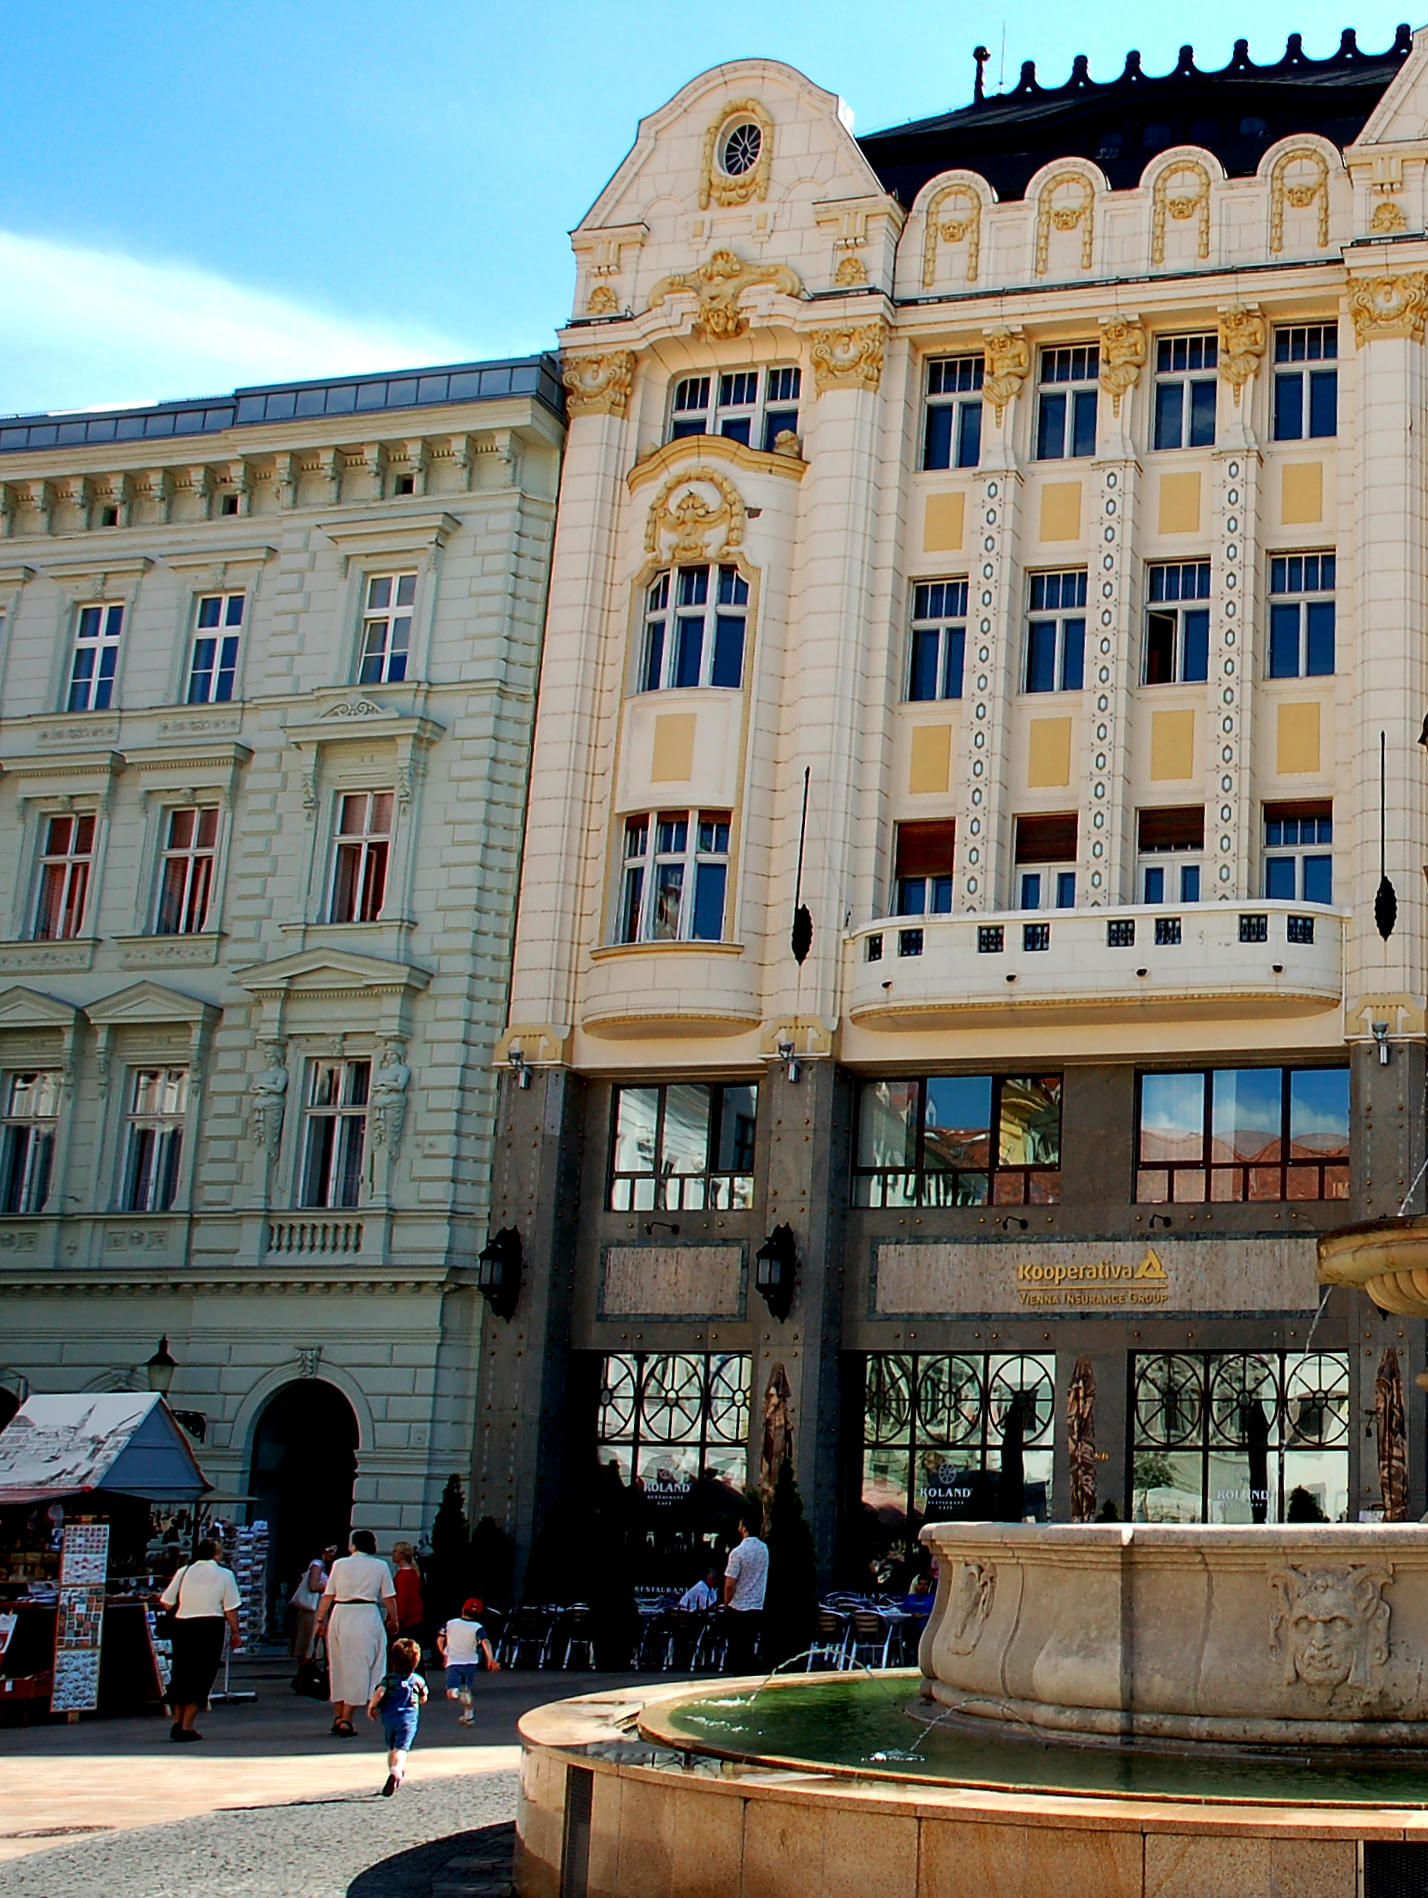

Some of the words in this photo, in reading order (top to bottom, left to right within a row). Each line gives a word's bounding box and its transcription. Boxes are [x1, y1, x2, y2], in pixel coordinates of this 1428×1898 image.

[1018, 1260, 1133, 1285] Kooperativa
[1020, 1293, 1059, 1305] VIENNA
[1063, 1292, 1126, 1305] INSURANCE
[1130, 1291, 1168, 1305] GROUP
[920, 1487, 971, 1498] ROLAND
[1216, 1489, 1270, 1500] ROLND
